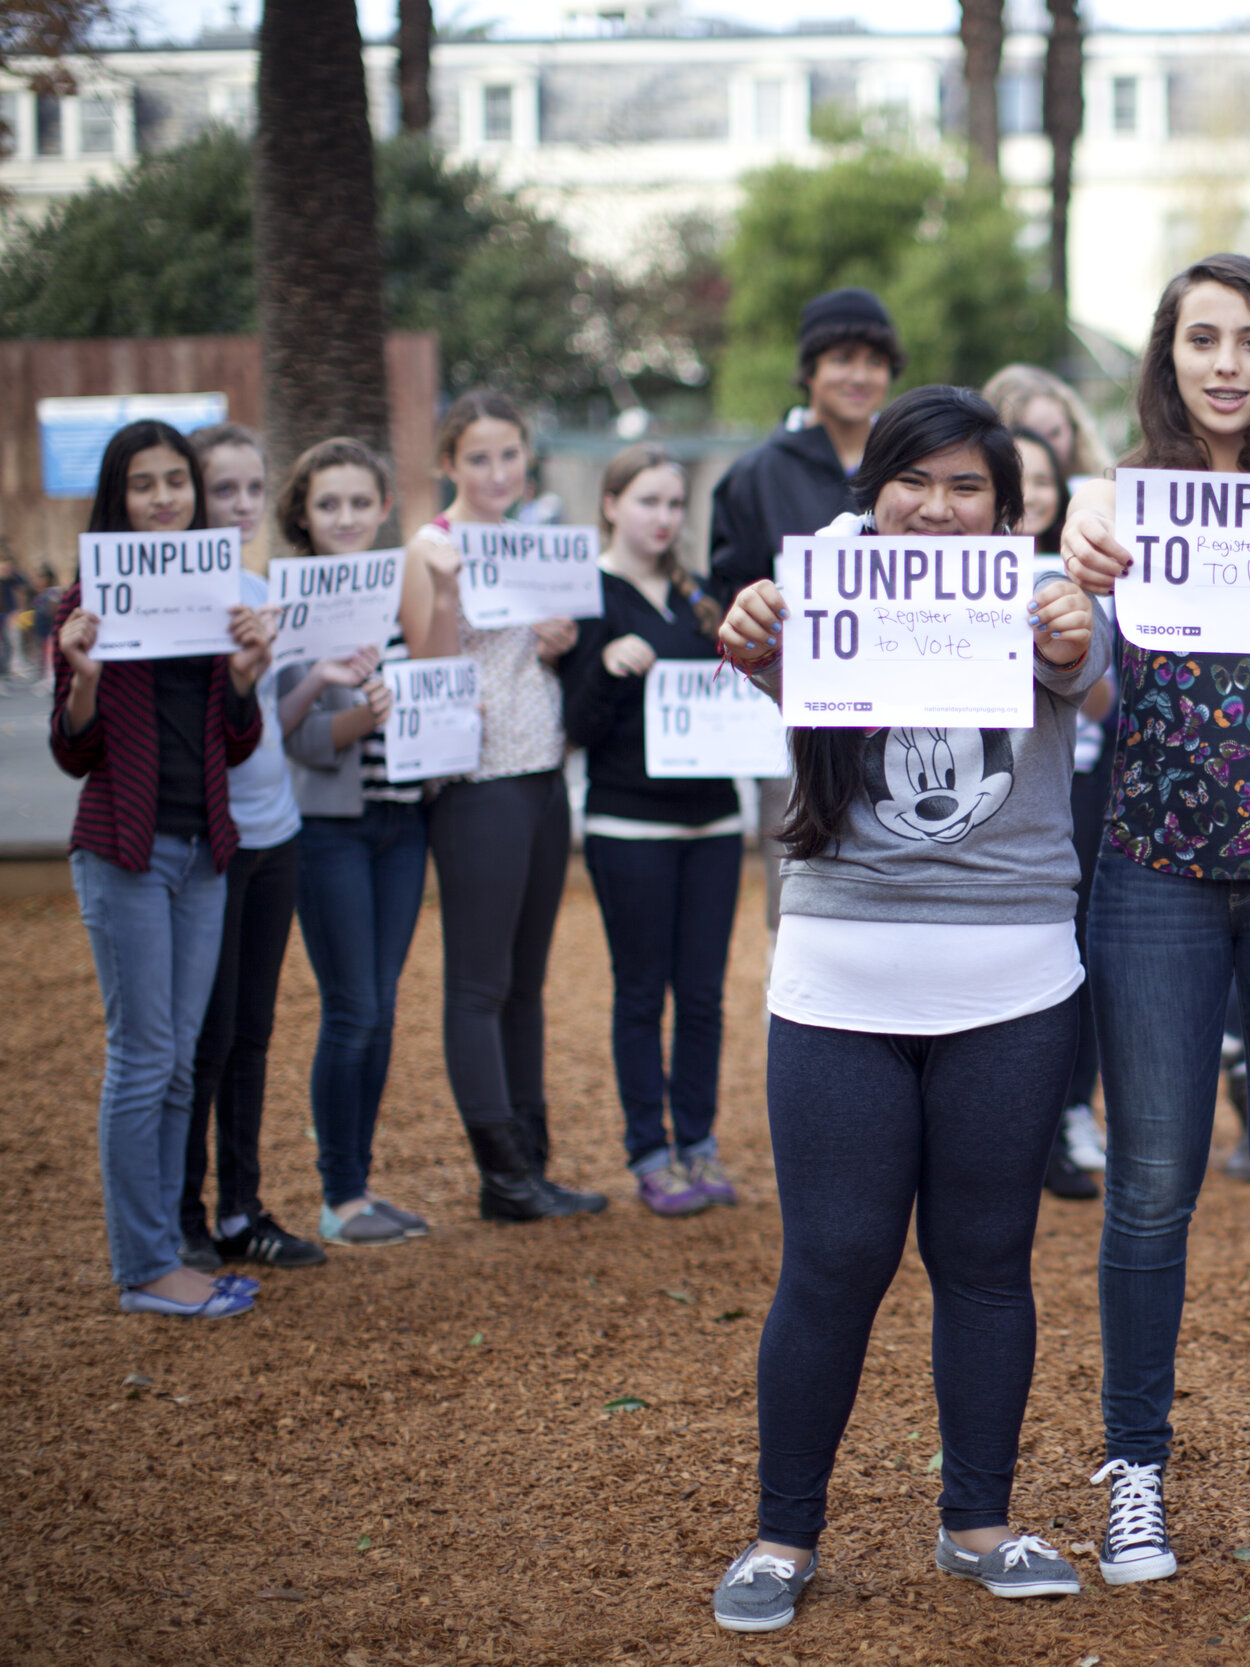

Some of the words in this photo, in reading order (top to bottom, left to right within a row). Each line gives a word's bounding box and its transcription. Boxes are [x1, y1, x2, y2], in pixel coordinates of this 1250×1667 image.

[1136, 480, 1145, 525] I
[93, 543, 100, 577] I
[116, 538, 231, 576] UNPLUG
[462, 531, 469, 555] I
[481, 532, 588, 562] UNPLUG
[1136, 535, 1190, 585] TO
[281, 569, 287, 599] I
[300, 558, 396, 597] UNPLUG
[465, 560, 498, 590] TO
[804, 549, 812, 600] I
[837, 549, 1019, 601] UNPLUG
[1203, 563, 1238, 585] TO
[96, 583, 132, 616] TO
[279, 602, 309, 630] TO
[873, 607, 952, 632] Register
[965, 607, 1012, 629] People
[1136, 625, 1182, 636] REBOOT
[804, 609, 859, 660] TO
[874, 635, 899, 653] to
[913, 634, 974, 659] Vote
[395, 673, 401, 702] I
[410, 665, 476, 702] UNPLUG
[659, 672, 666, 700] I
[660, 706, 691, 735] TO
[804, 702, 853, 712] REBOOT
[397, 707, 420, 739] TO
